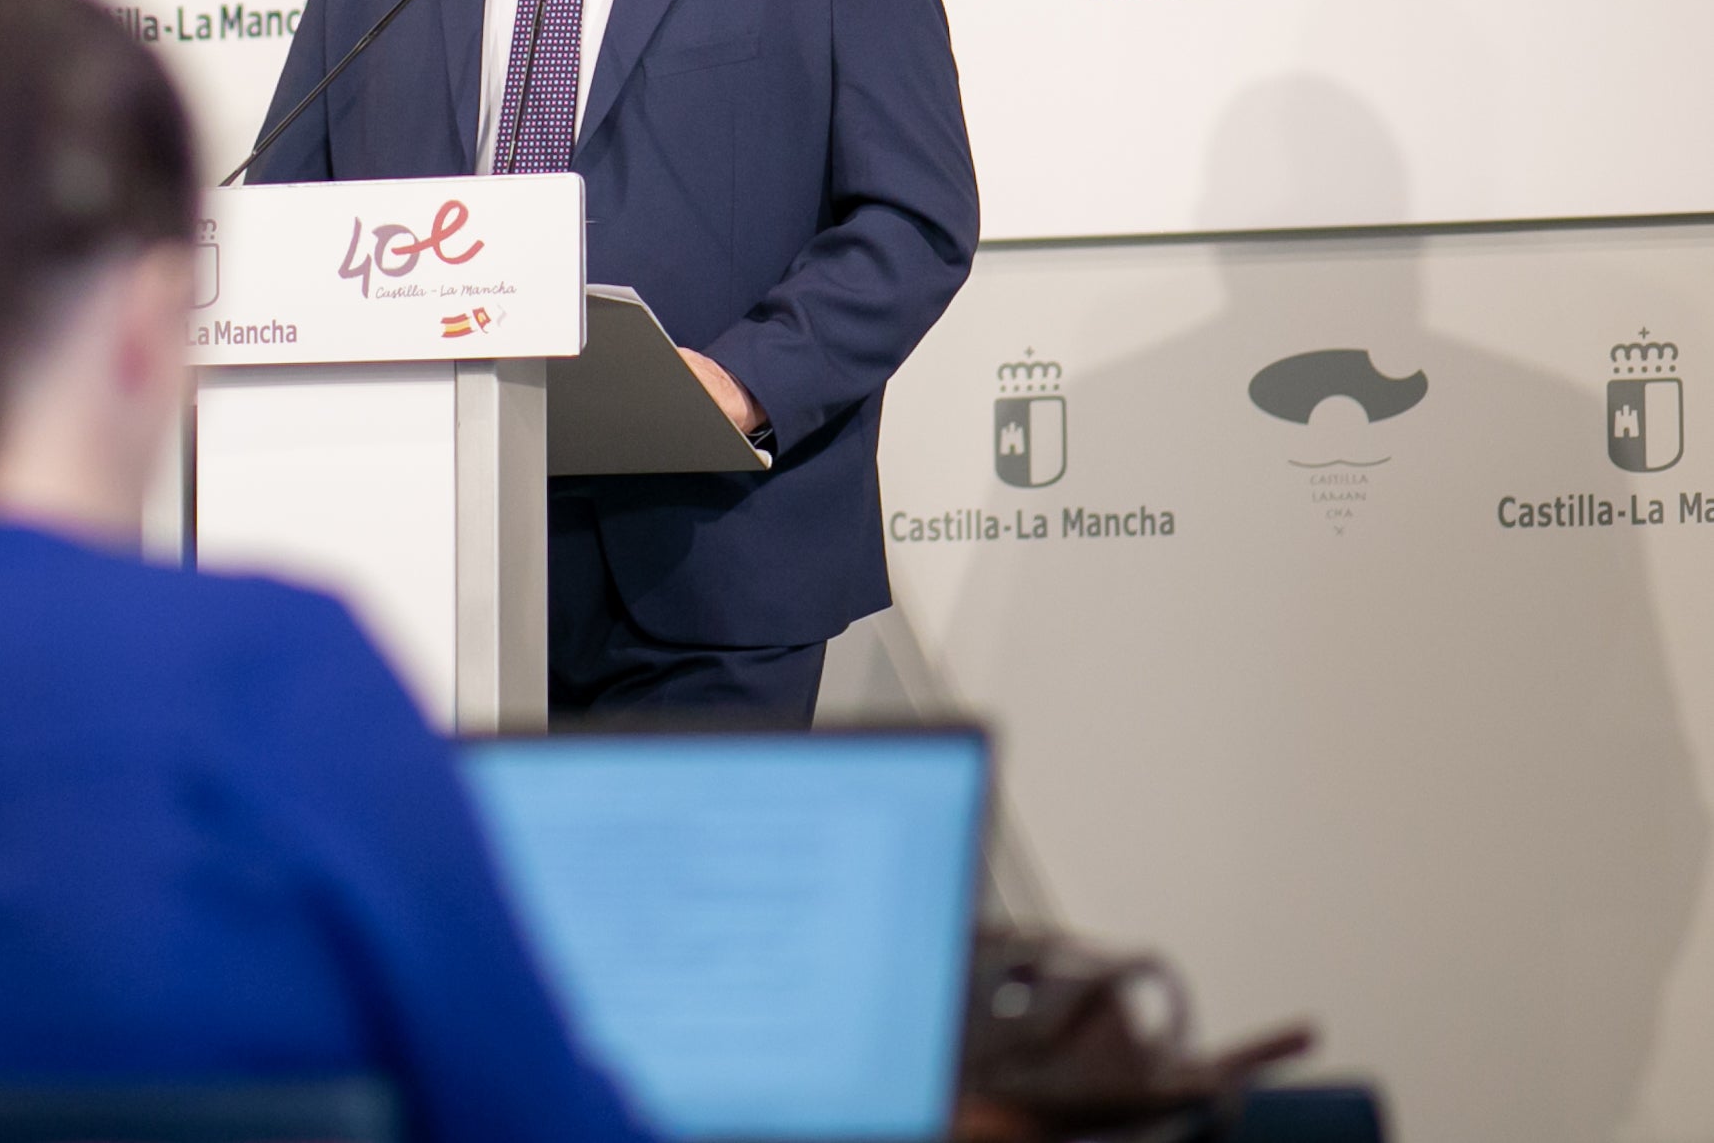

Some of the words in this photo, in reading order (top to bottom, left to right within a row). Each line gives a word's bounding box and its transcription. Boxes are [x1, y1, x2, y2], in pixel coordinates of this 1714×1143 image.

[220, 4, 301, 39] Manc
[375, 286, 426, 299] Castilla
[440, 285, 457, 297] La
[460, 281, 517, 297] Mancha
[214, 319, 297, 345] Mancha
[889, 510, 1049, 542] Castilla-La
[1062, 507, 1175, 538] Mancha
[1497, 493, 1664, 528] Castilla-La
